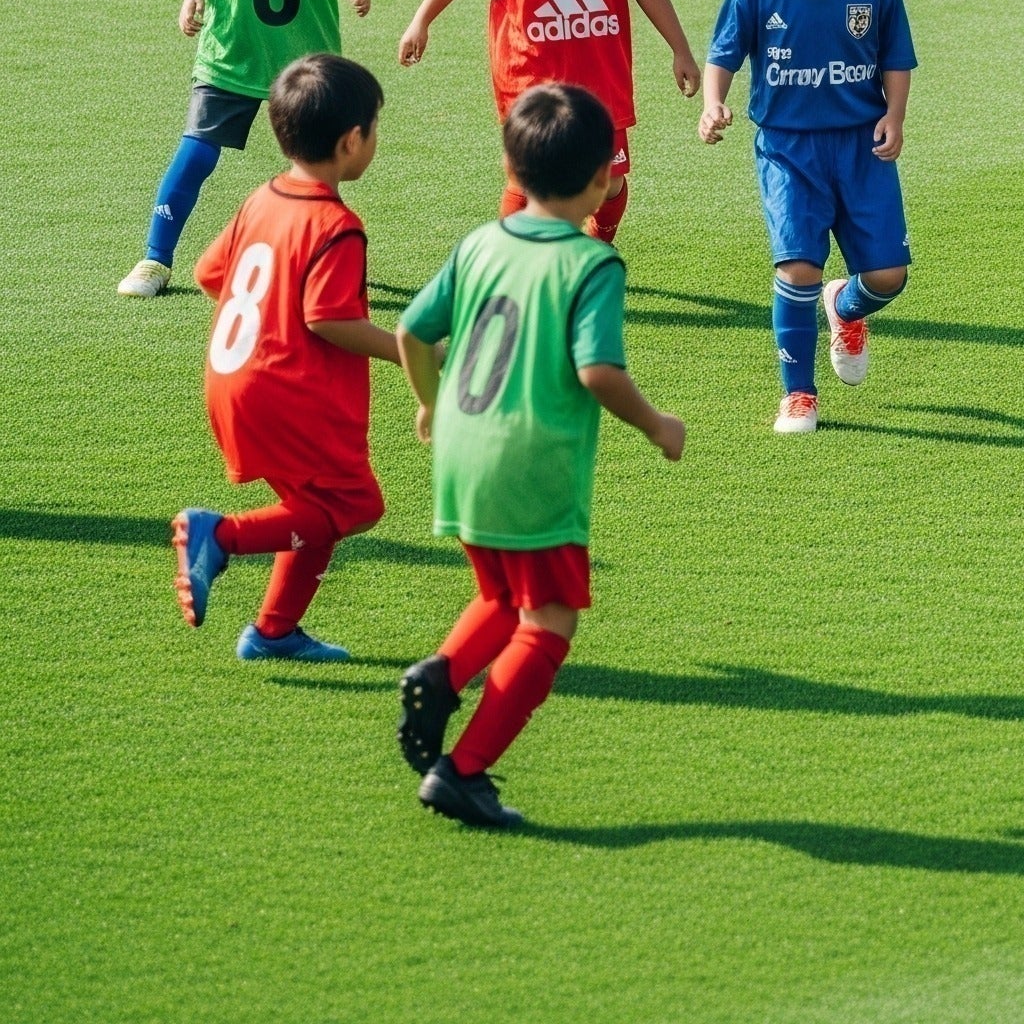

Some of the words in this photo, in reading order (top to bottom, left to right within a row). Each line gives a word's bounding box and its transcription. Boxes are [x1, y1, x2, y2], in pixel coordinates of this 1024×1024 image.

[527, 11, 620, 43] adidas
[209, 242, 274, 375] 8
[457, 295, 519, 416] 0
